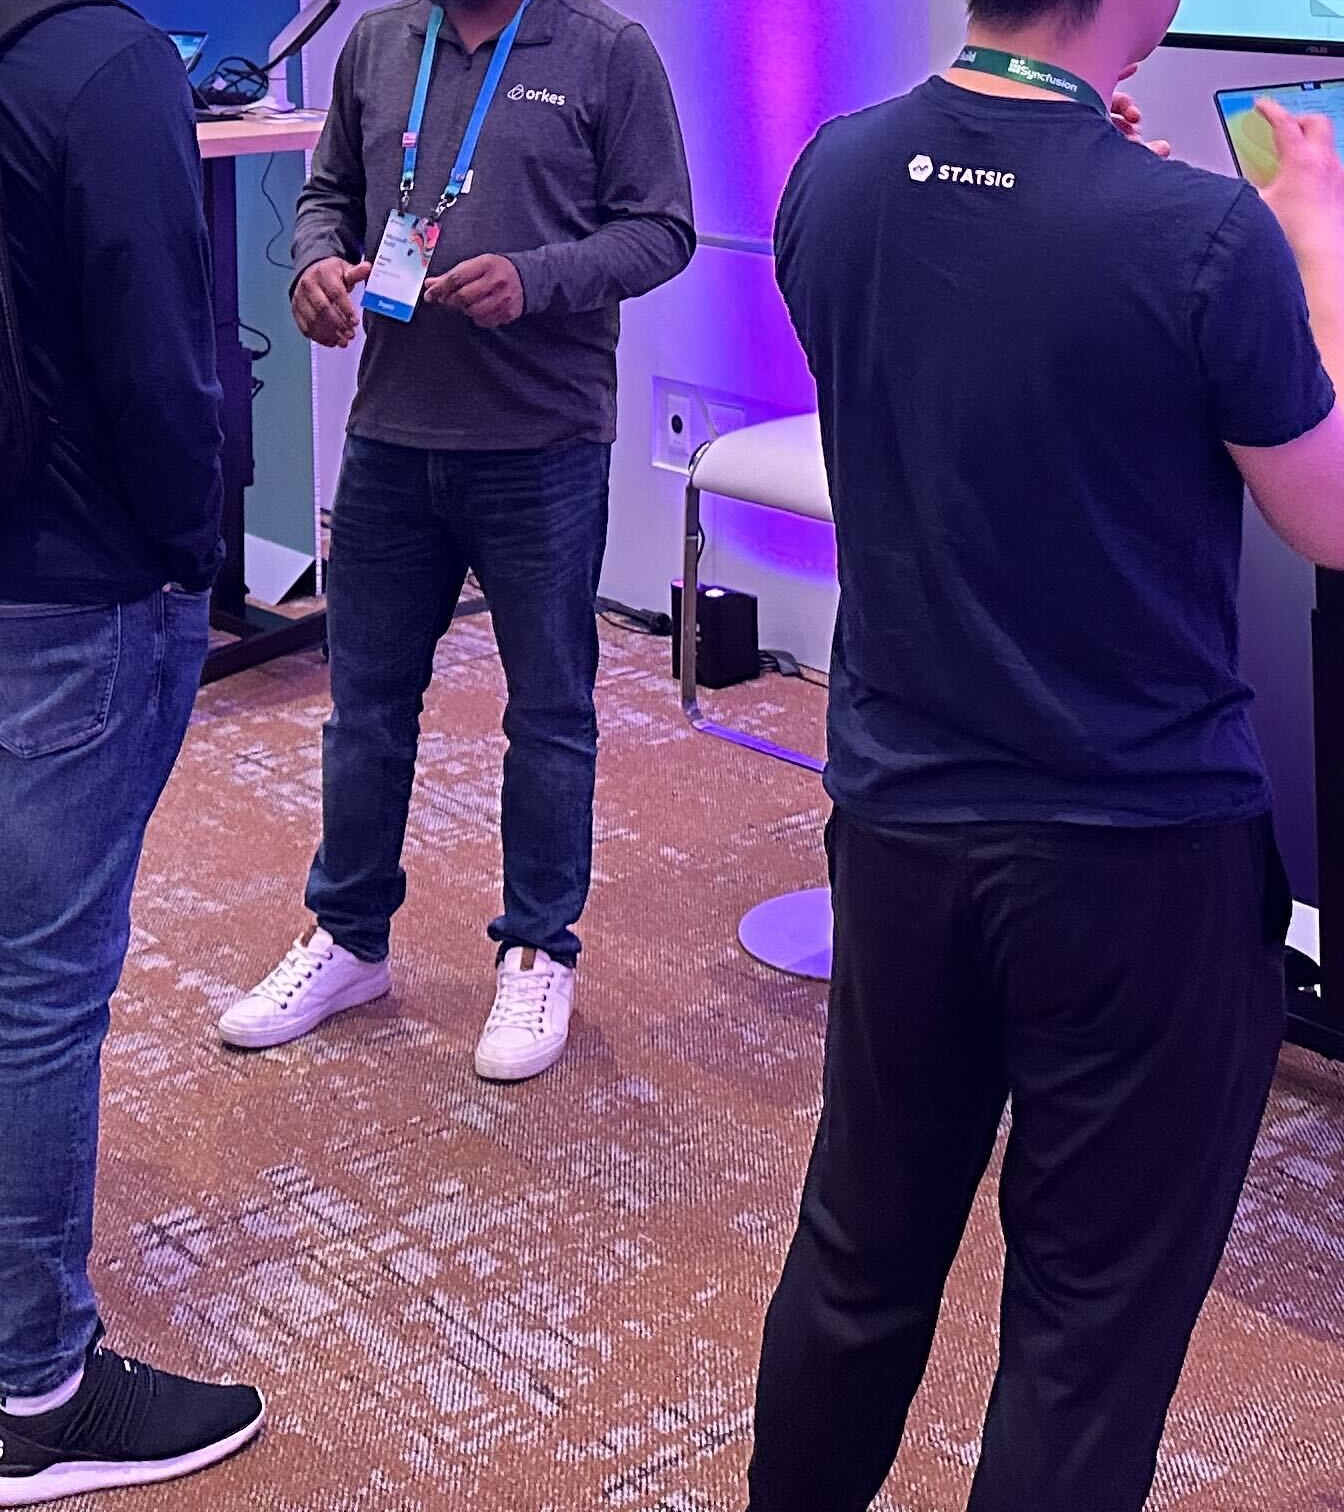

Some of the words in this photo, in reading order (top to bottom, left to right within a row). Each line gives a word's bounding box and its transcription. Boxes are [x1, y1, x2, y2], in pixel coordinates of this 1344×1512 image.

[1020, 66, 1078, 93] Syncfusion
[526, 88, 566, 106] orkes
[938, 164, 1016, 189] STATSIG
